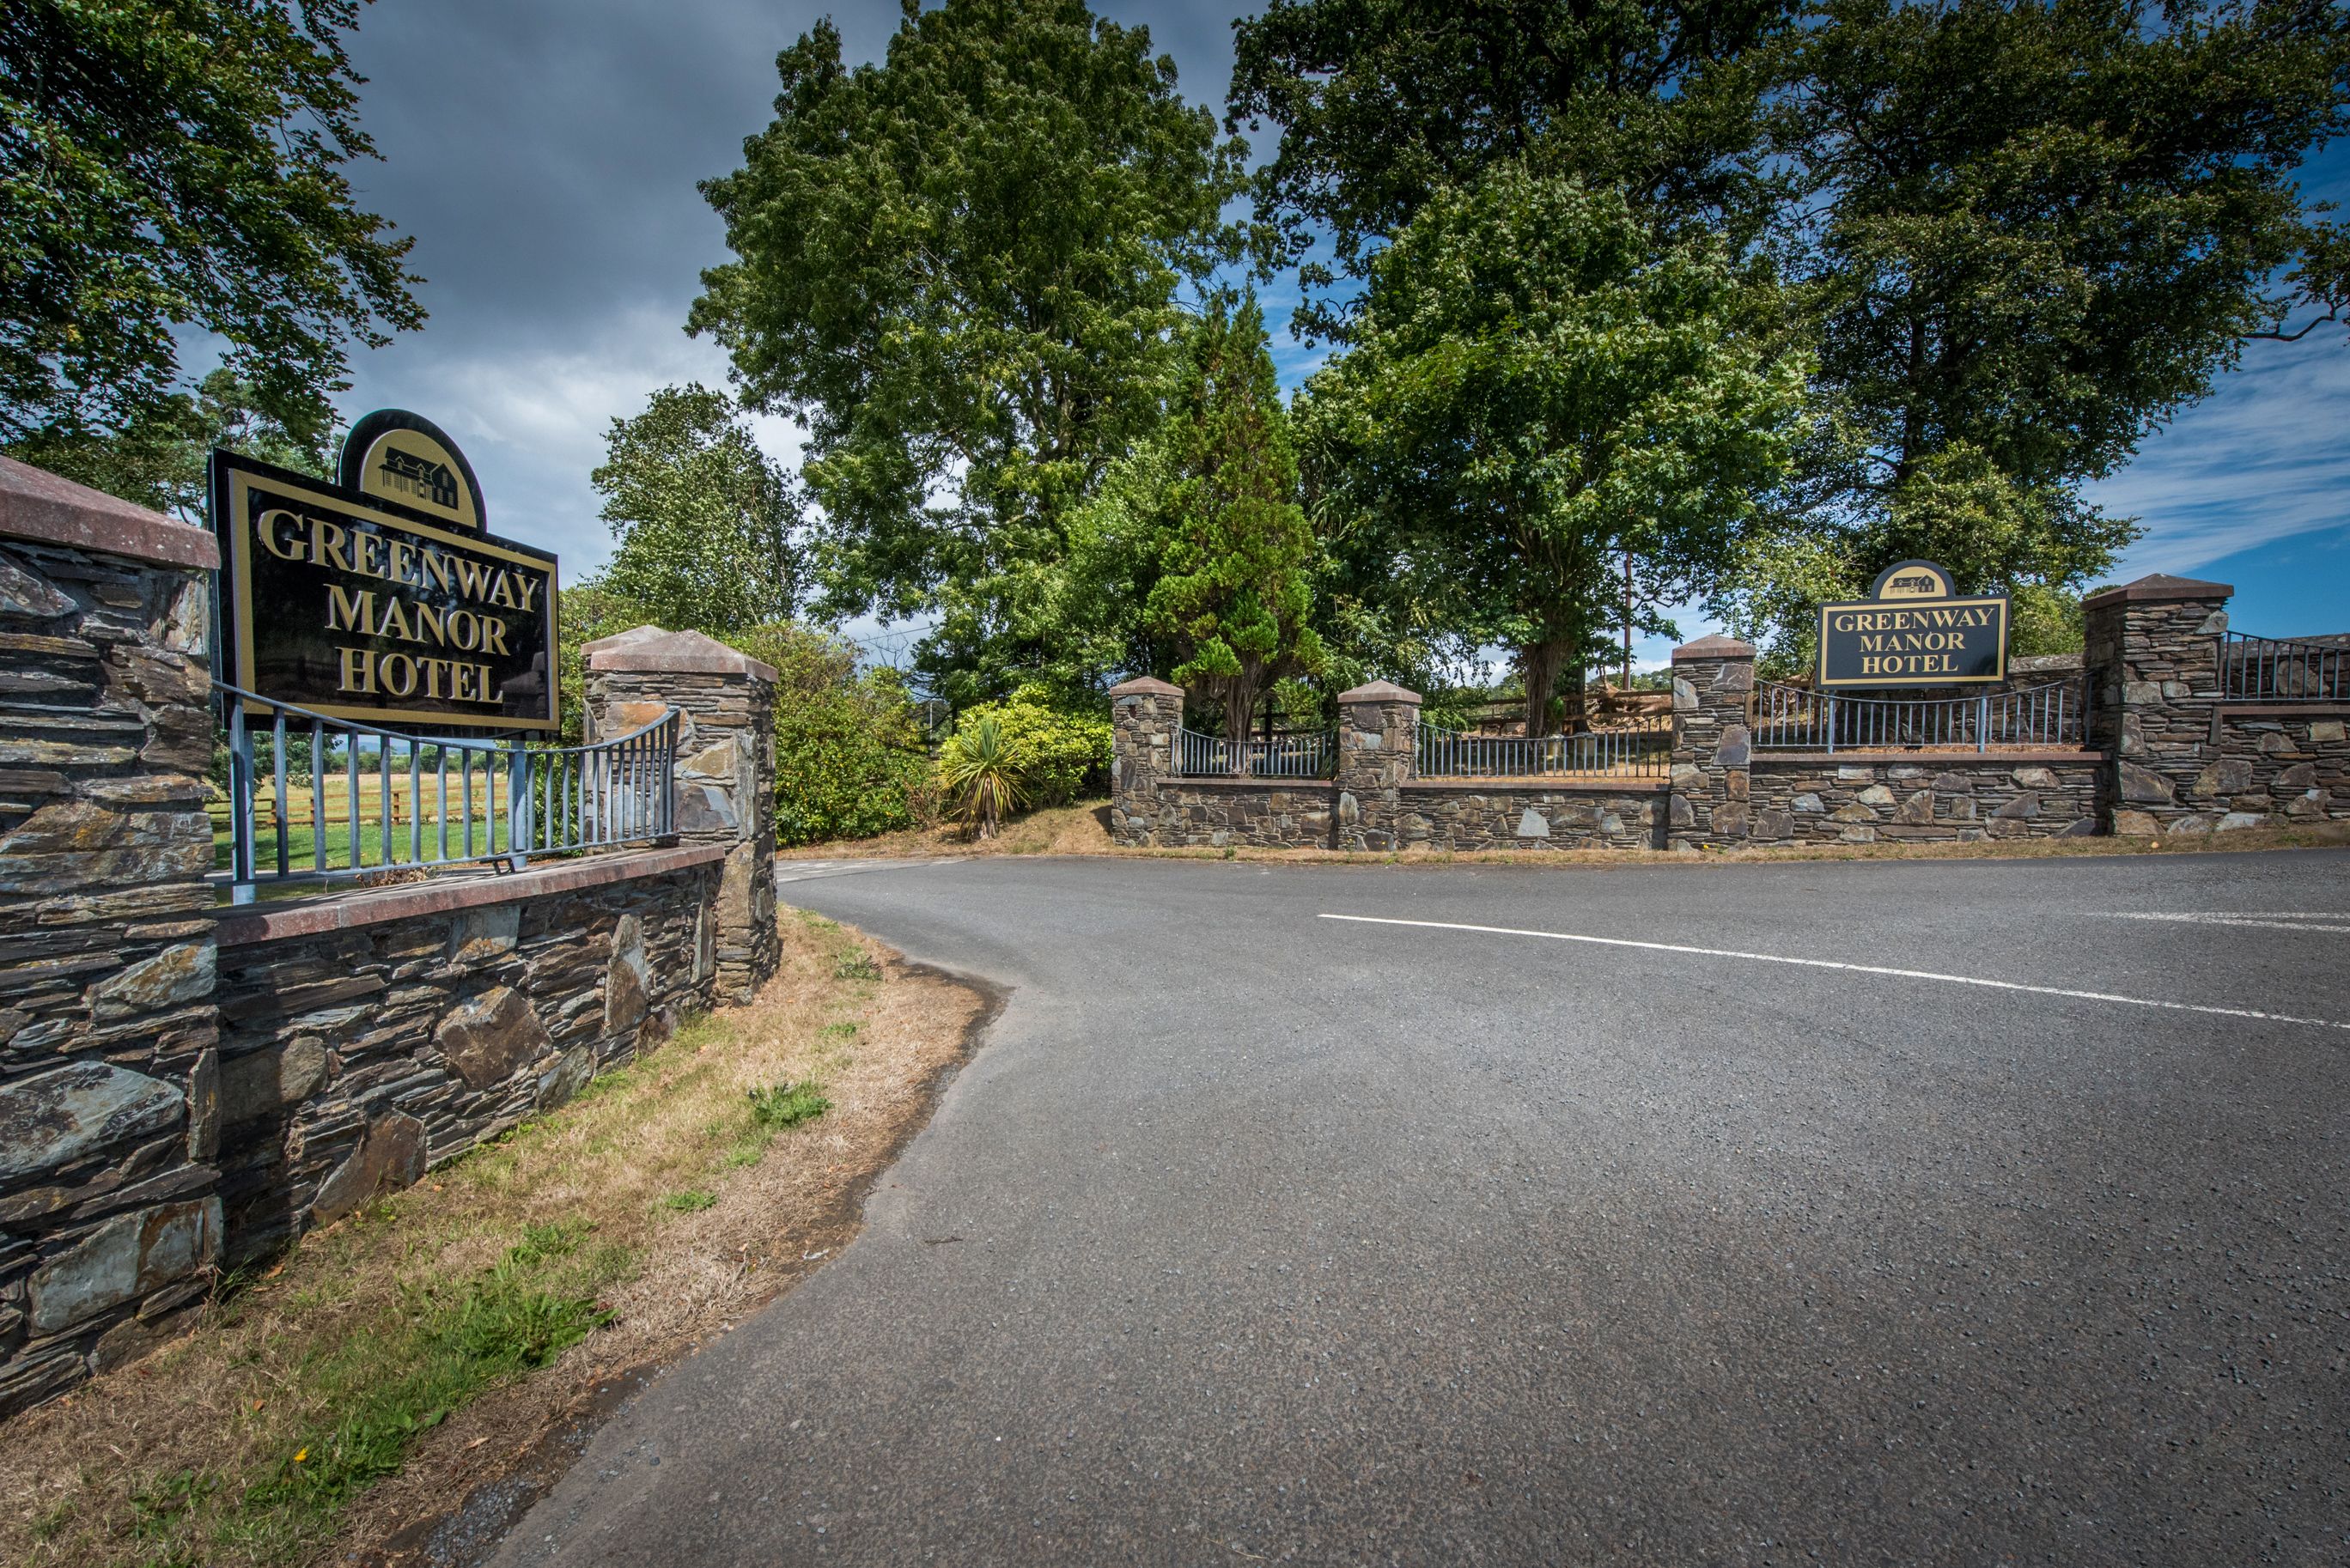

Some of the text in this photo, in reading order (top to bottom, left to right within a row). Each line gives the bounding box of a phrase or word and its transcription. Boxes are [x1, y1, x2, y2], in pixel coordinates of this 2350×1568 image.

[258, 508, 539, 613] GREENWAY
[323, 583, 511, 656] MANOR
[1835, 608, 1995, 632] GREENWAY
[1859, 632, 1966, 653] MANOR
[335, 647, 503, 704] HOTEL
[1861, 654, 1958, 674] HOTEL
